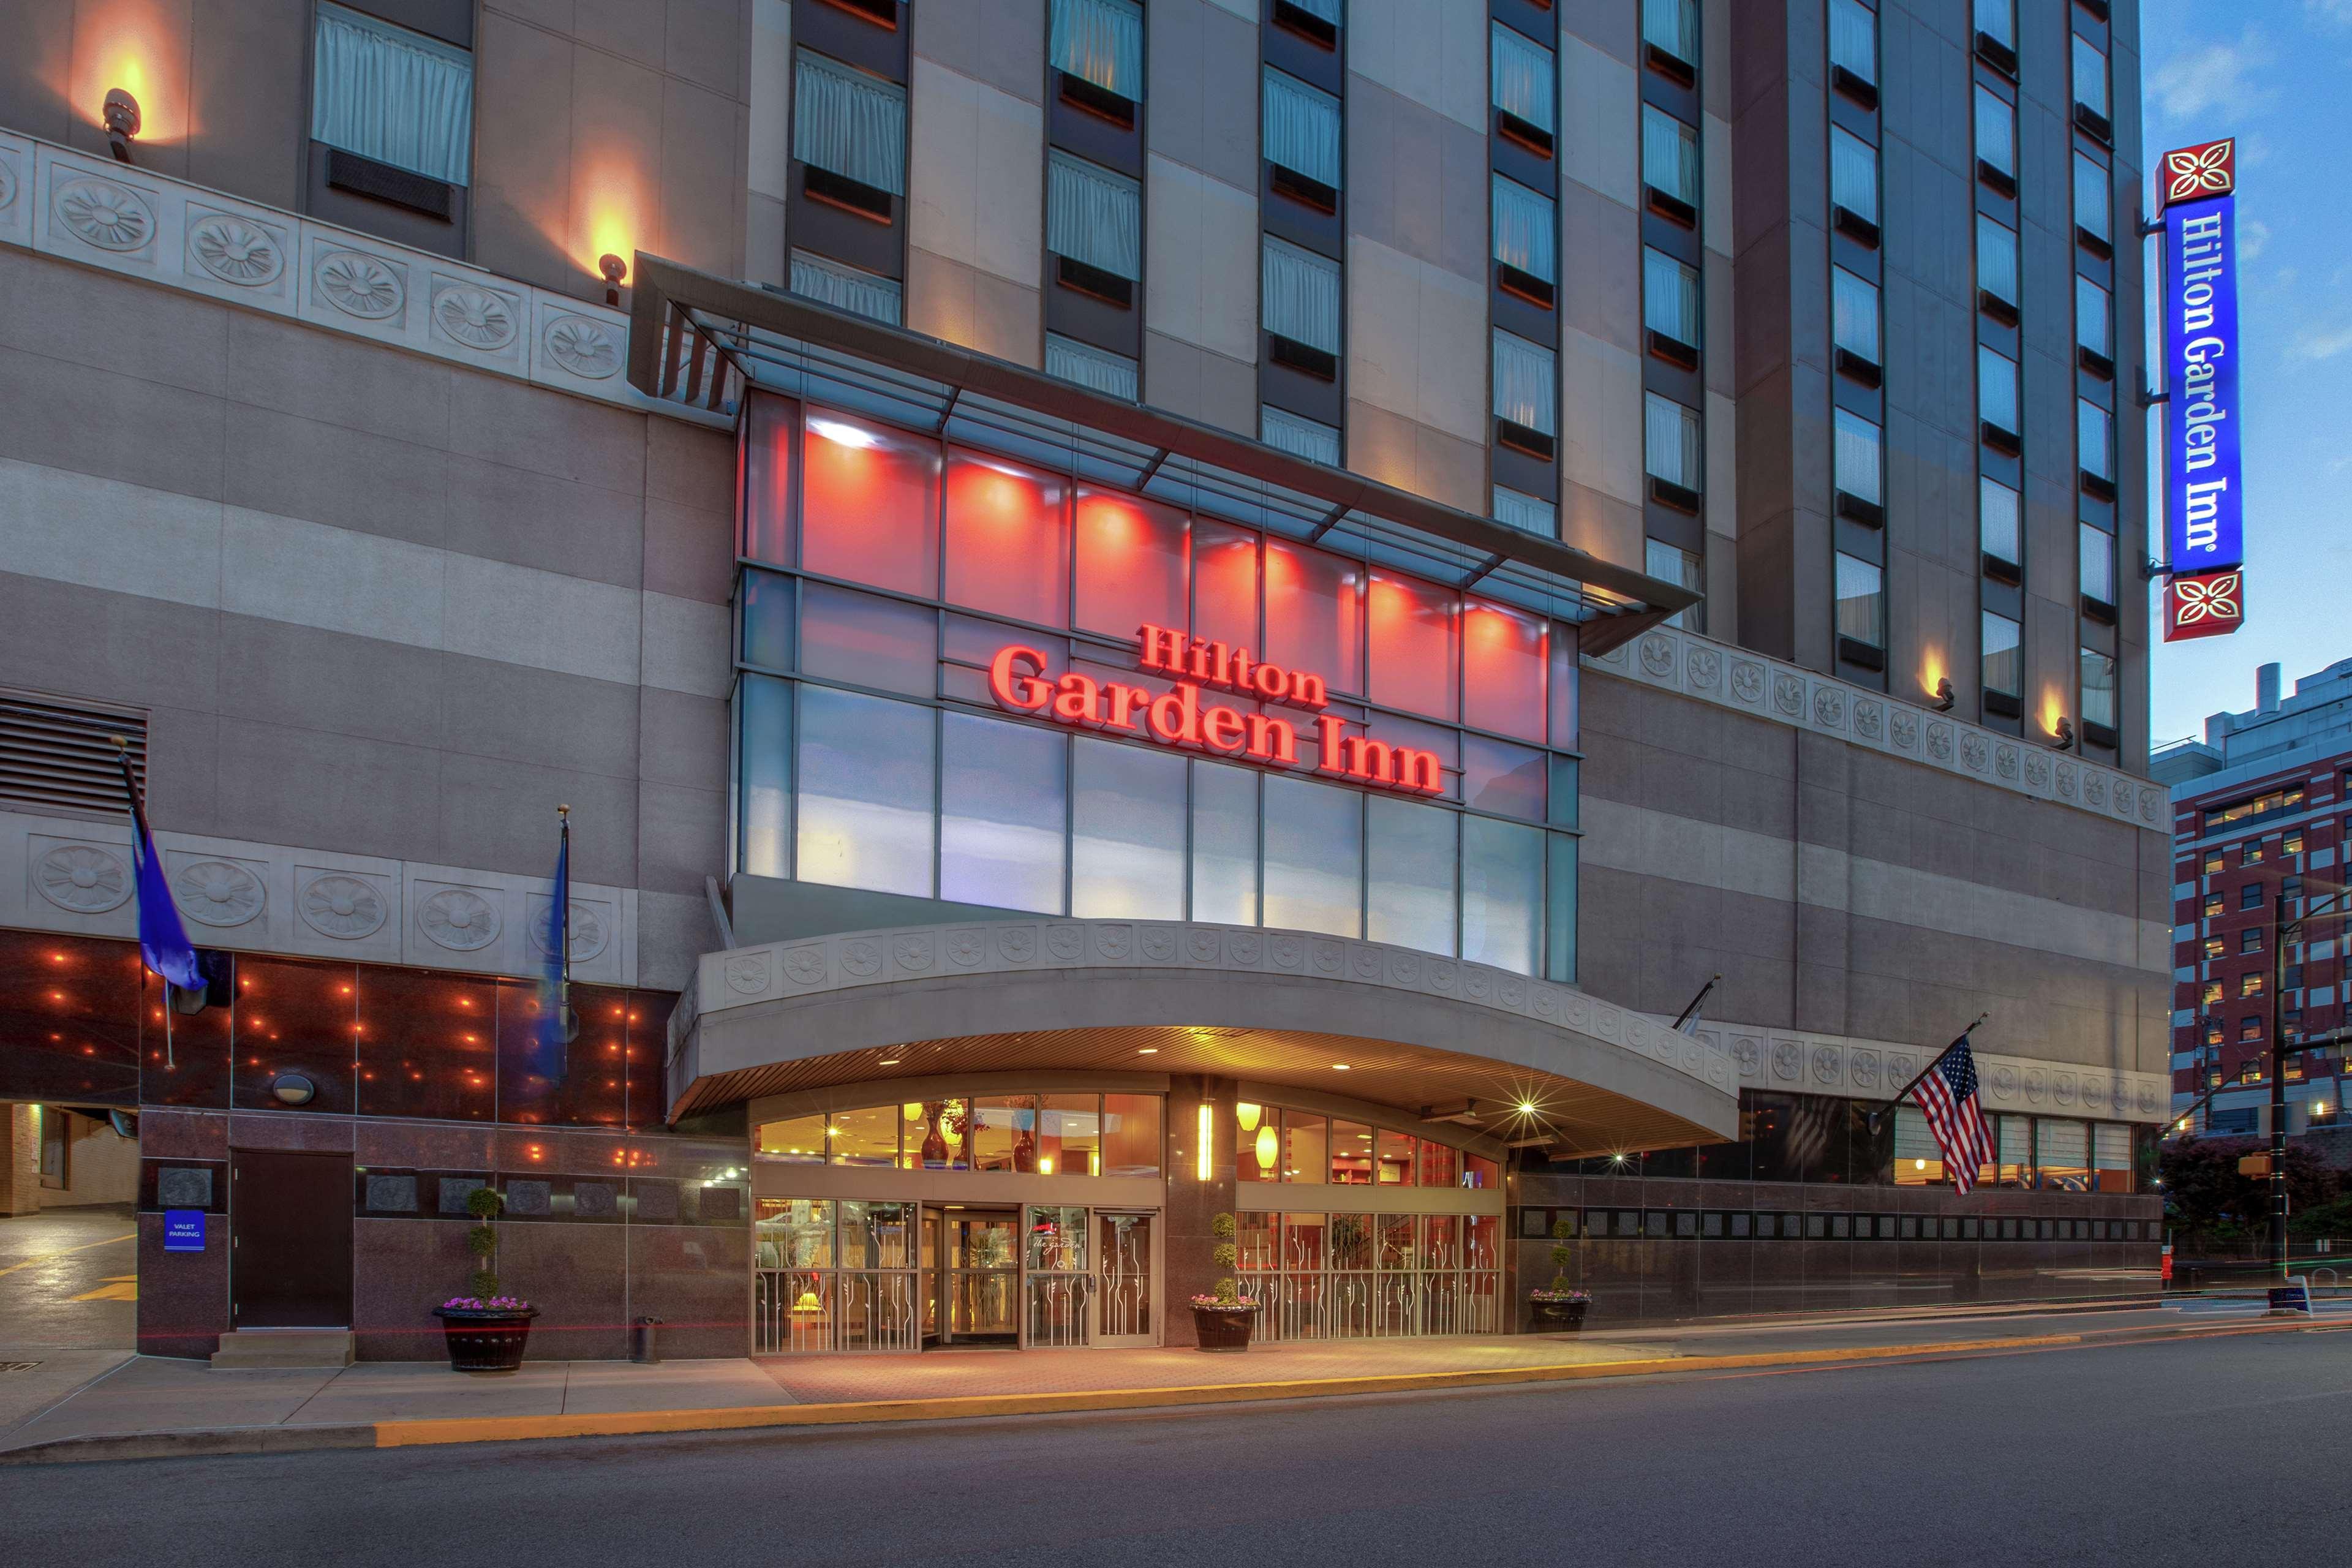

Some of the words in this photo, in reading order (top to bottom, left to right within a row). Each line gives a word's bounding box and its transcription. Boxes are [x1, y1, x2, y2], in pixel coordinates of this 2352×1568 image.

[2182, 211, 2222, 334] Hilton
[2184, 337, 2226, 473] Garden
[989, 645, 1298, 765] Garden
[1319, 714, 1445, 794] Inn
[1139, 623, 1329, 709] Hilton
[1033, 1238, 1047, 1247] the
[1043, 1238, 1081, 1255] garden
